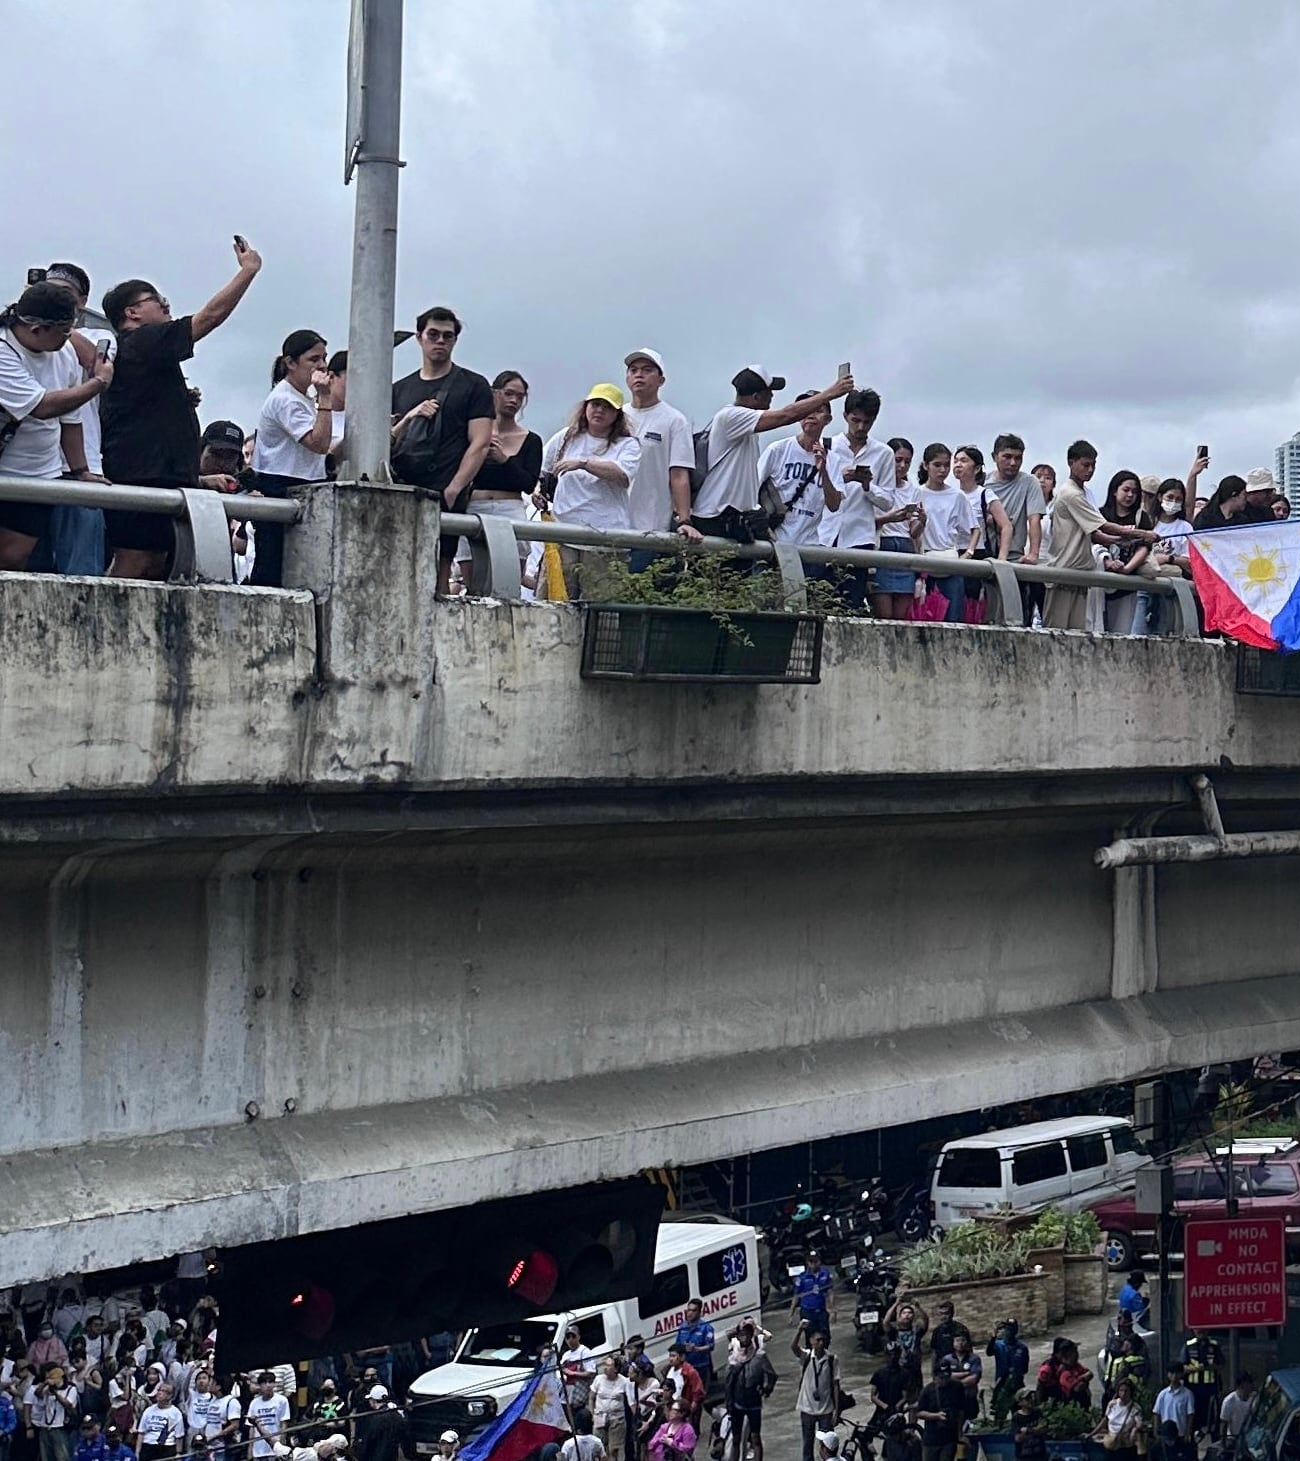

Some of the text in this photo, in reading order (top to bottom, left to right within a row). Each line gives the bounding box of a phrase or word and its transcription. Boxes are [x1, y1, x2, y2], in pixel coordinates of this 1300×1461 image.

[1228, 1227, 1268, 1240] MMDA
[1238, 1244, 1258, 1257] NO
[1217, 1261, 1278, 1276] CONTACT
[1190, 1282, 1280, 1298] APPREHENSION
[655, 1291, 737, 1335] AMBANCE
[1210, 1301, 1267, 1315] IN EFFECT
